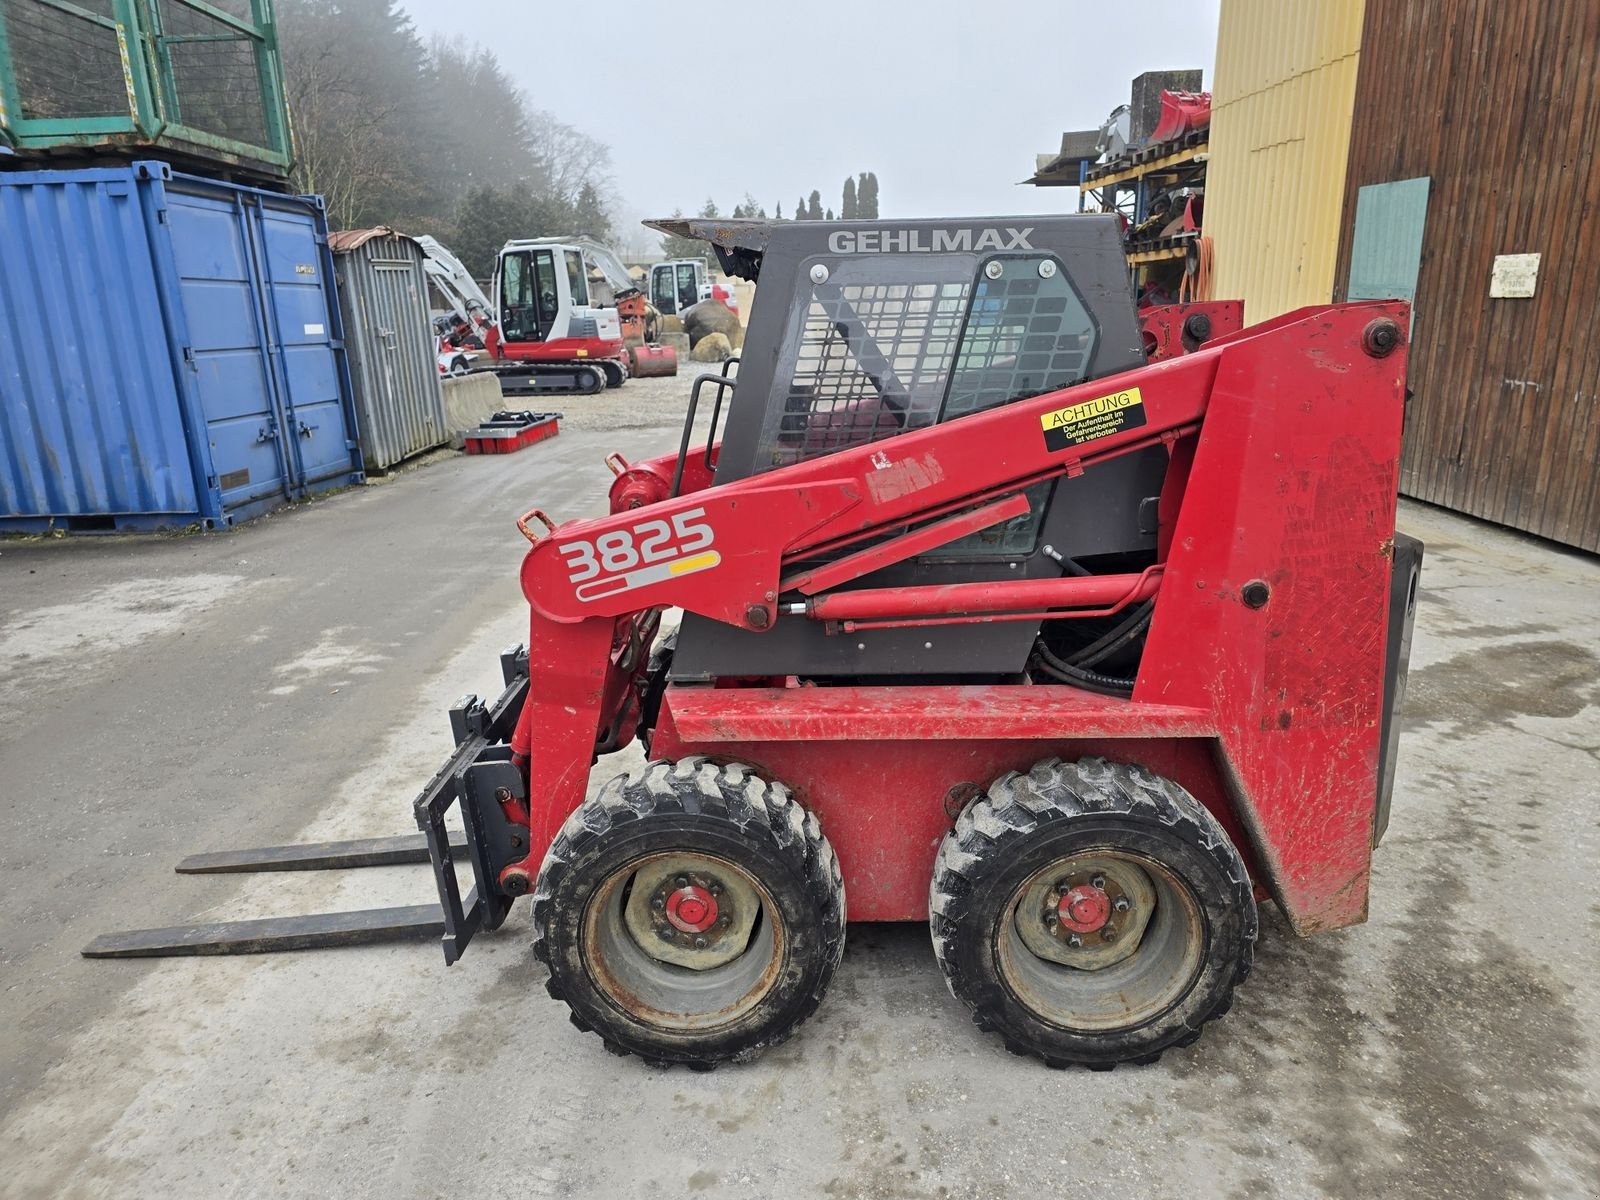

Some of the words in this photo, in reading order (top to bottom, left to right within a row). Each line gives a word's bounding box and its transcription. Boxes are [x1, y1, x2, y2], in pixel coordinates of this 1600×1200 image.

[828, 227, 1035, 254] GEHLMAX
[1052, 393, 1131, 426] ACHTUNG
[1063, 424, 1077, 434] Der
[1077, 412, 1114, 429] Aufenthalt
[1066, 418, 1124, 439] Gefahrenbereich
[1086, 427, 1117, 441] verboten
[558, 507, 715, 584] 3825
